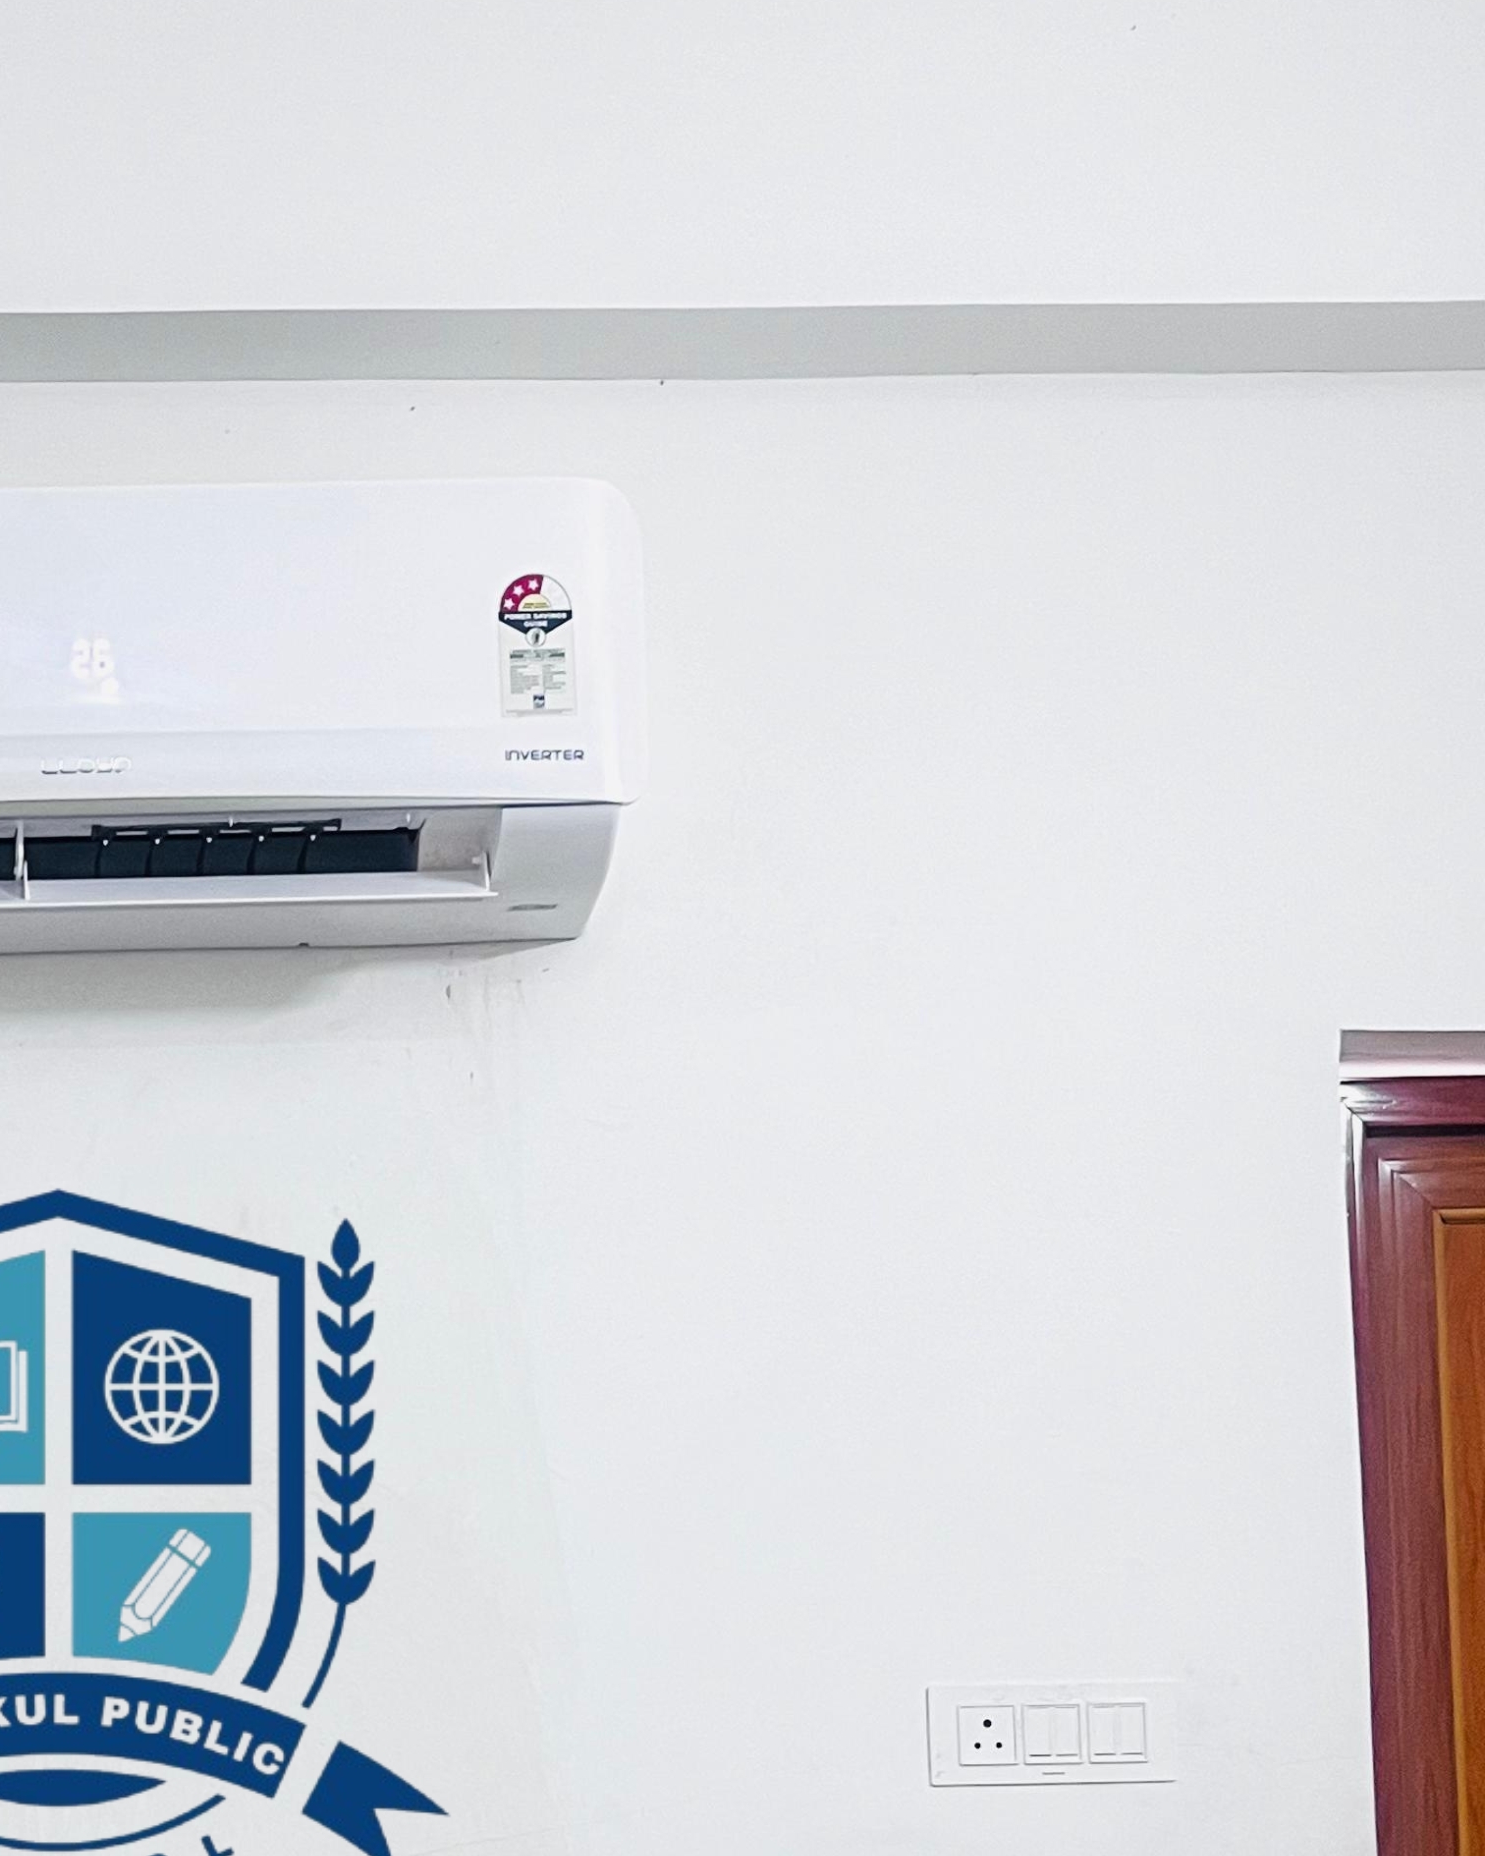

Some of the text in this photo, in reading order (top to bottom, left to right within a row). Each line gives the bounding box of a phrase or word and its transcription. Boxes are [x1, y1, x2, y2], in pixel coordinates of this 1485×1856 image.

[71, 637, 115, 680] 26
[504, 749, 585, 762] INVERTER
[100, 1695, 286, 1775] PUBLIC
